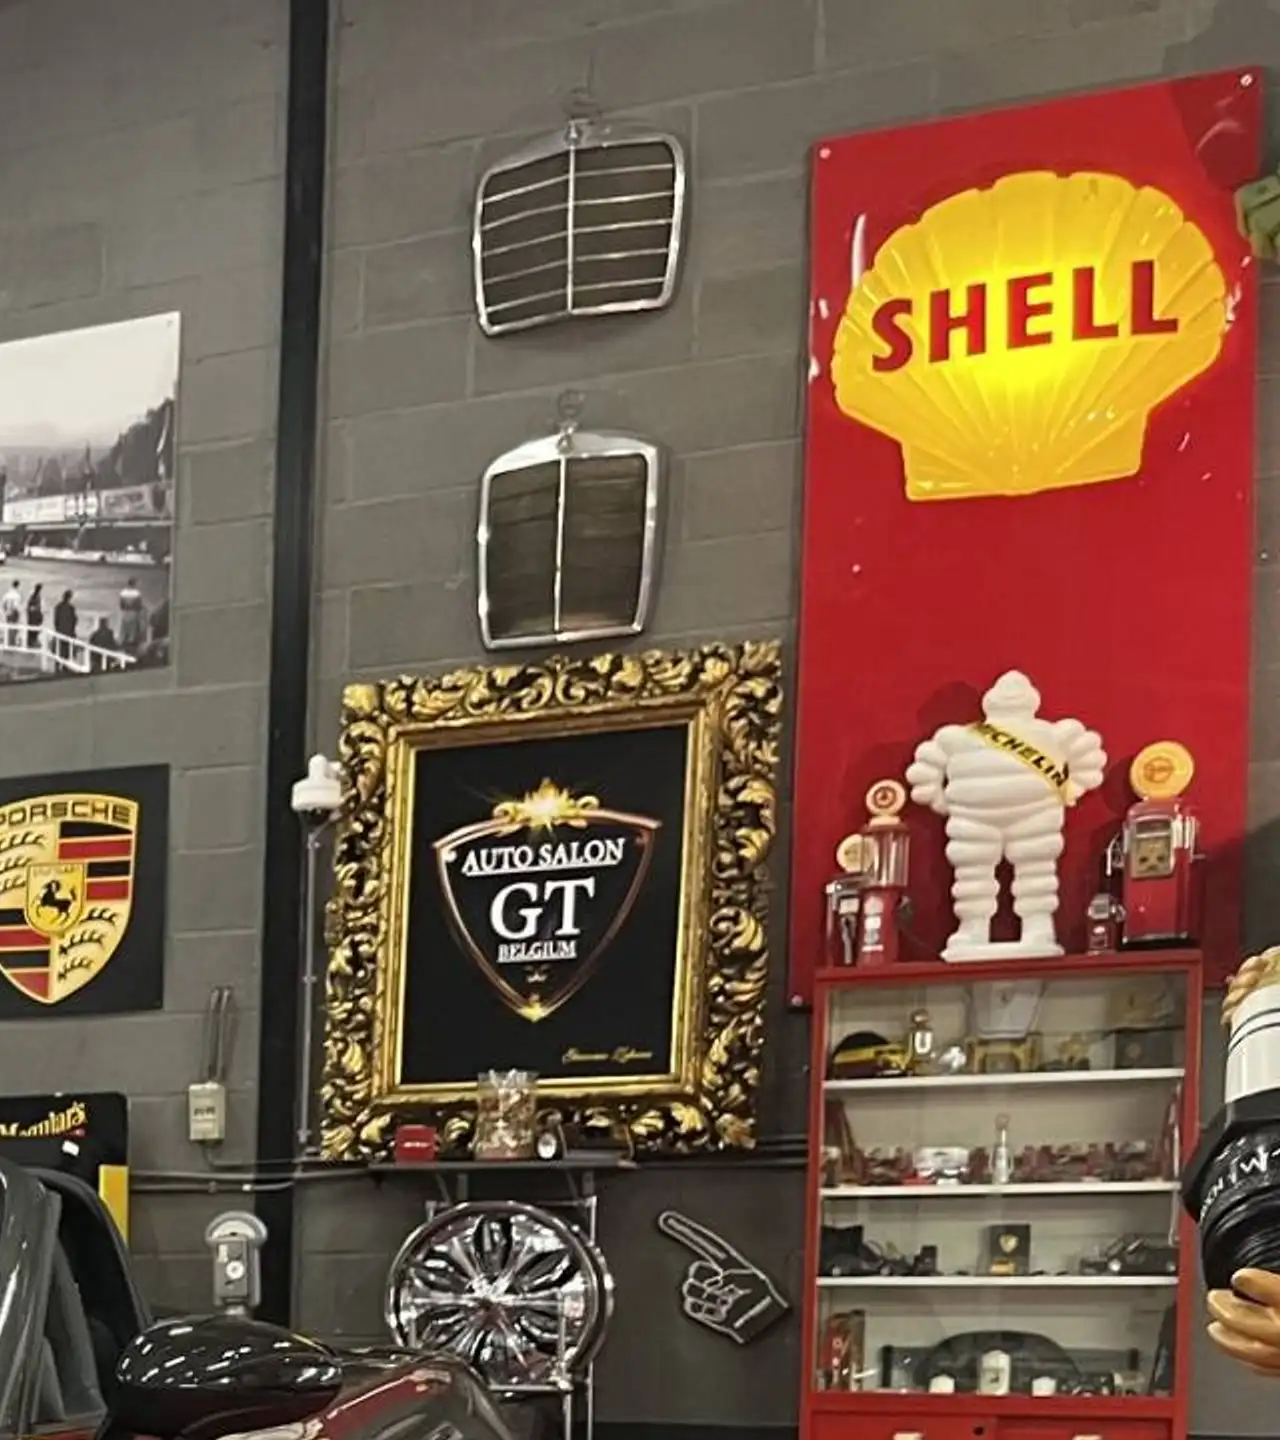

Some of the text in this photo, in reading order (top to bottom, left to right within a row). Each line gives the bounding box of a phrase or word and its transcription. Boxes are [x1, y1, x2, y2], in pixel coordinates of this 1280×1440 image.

[871, 259, 1179, 372] SHELL
[461, 838, 626, 873] AUTO SALON
[491, 876, 595, 940] GT
[497, 940, 577, 962] BELGIUM
